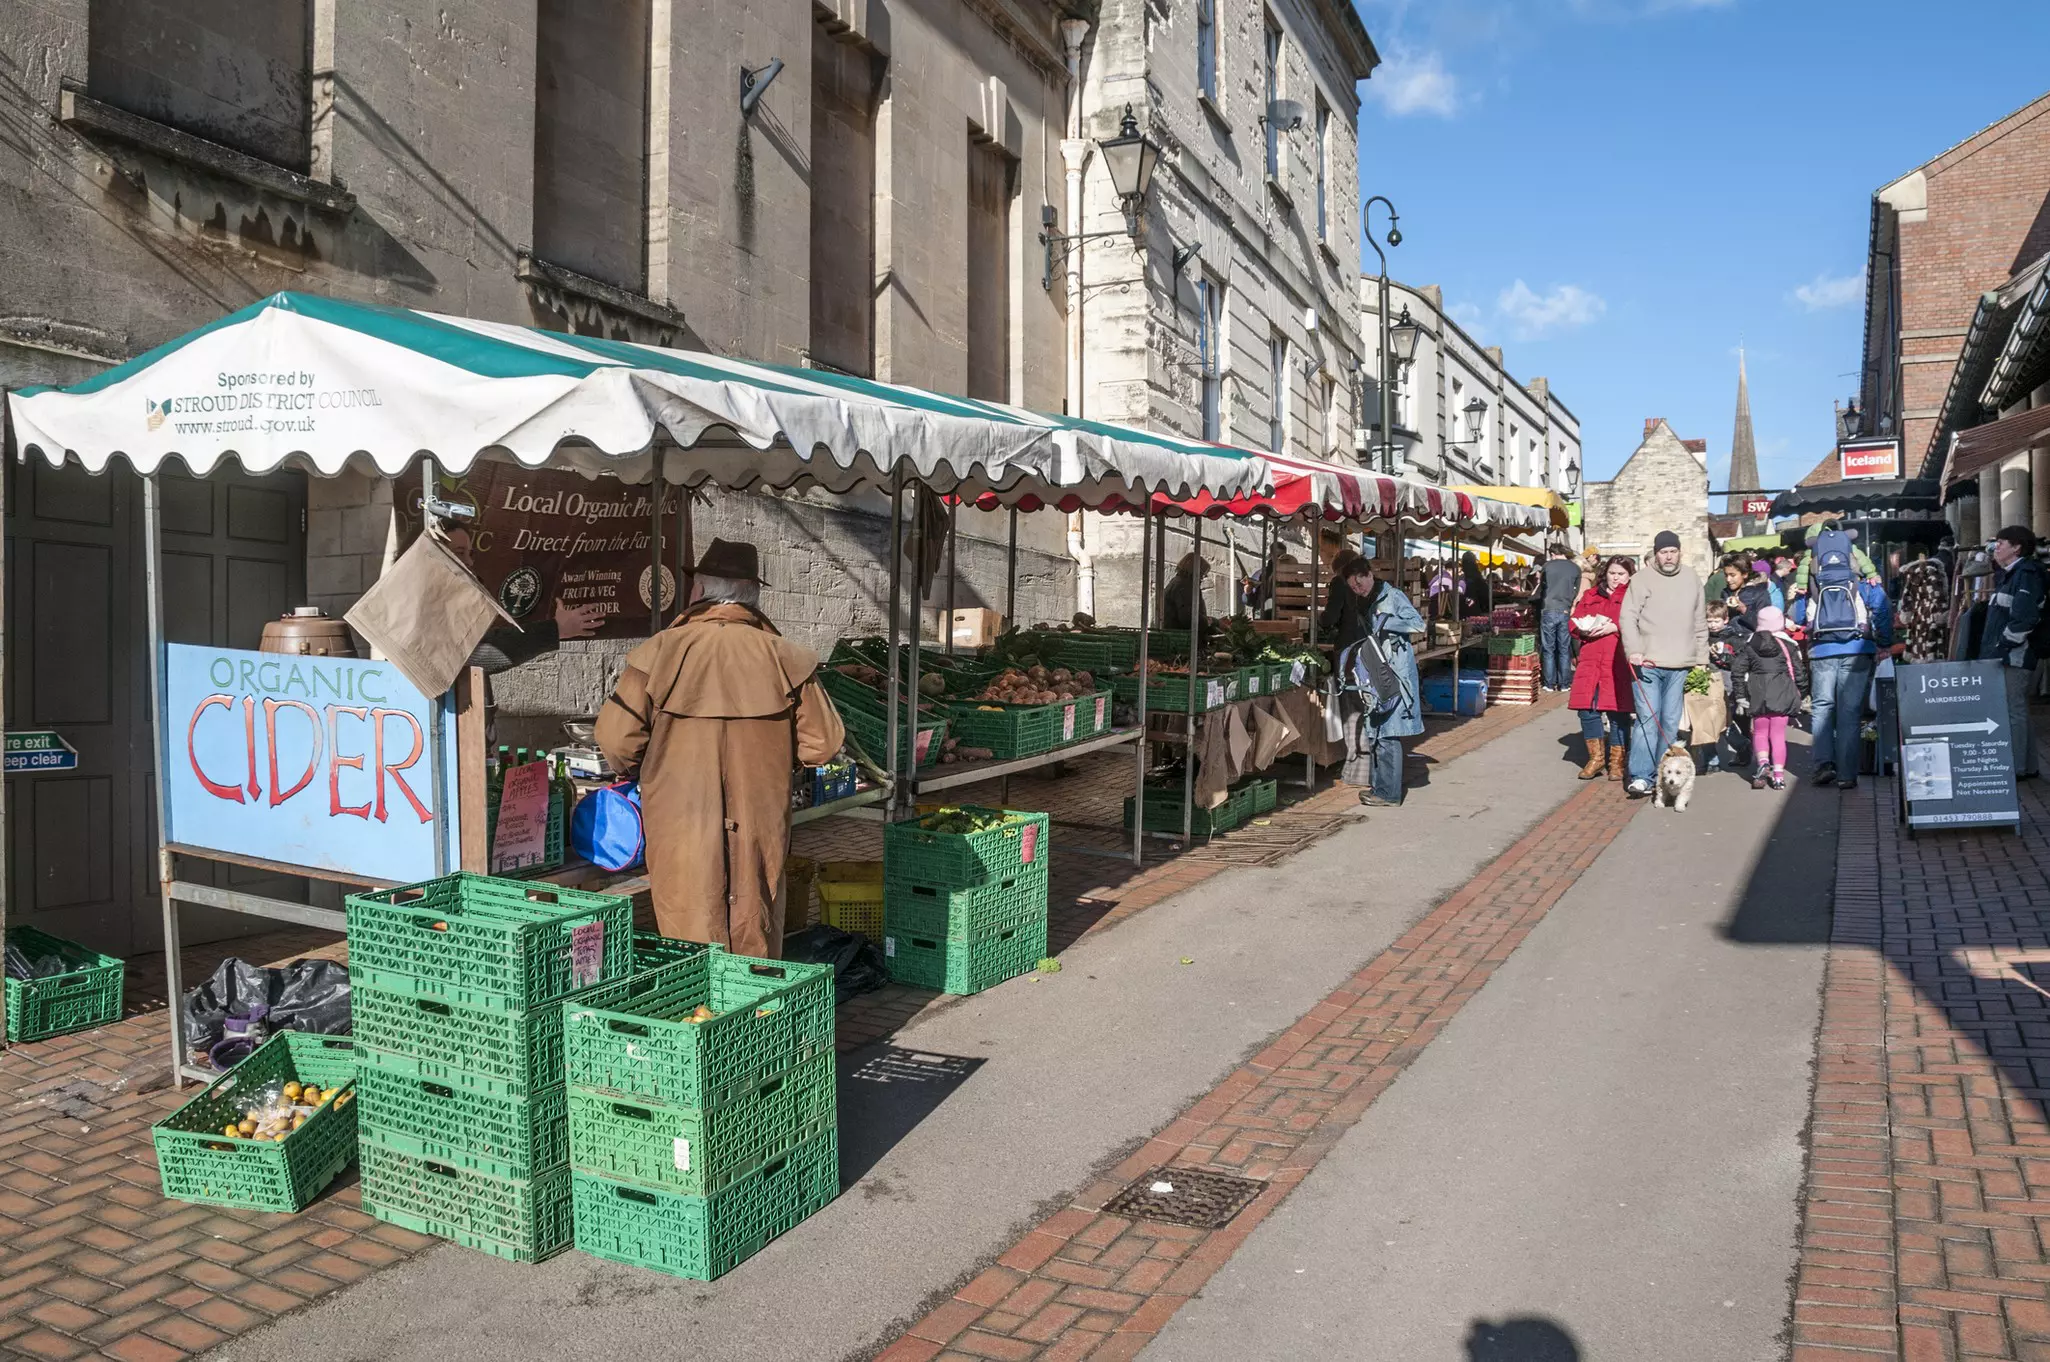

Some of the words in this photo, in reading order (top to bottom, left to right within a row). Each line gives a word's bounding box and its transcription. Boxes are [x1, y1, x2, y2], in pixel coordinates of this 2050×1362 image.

[218, 371, 296, 390] Sponsored
[300, 370, 314, 388] by
[174, 394, 238, 413] STROUD
[240, 392, 315, 410] DISTRICT
[318, 389, 382, 410] COUNCIL
[174, 415, 315, 434] www.stroud.gov.uk
[1847, 453, 1892, 467] Iceland
[502, 486, 564, 515] Local
[566, 491, 632, 524] Organic
[512, 529, 570, 552] Direct
[566, 532, 607, 558] from
[608, 532, 629, 551] the
[561, 570, 587, 582] Award
[588, 569, 622, 583] Winning
[562, 586, 590, 599] FRUIT
[590, 586, 596, 598] &
[598, 586, 616, 597] VEG
[210, 657, 388, 703] ORGANIC
[1920, 674, 1982, 694] JOSEPH
[1924, 694, 1980, 704] HAIRDRESSING
[24, 735, 50, 749] exit
[4, 756, 28, 768] eep
[31, 752, 63, 765] clear
[188, 693, 434, 824] CIDER
[1958, 780, 2008, 788] Appointments
[1972, 788, 2010, 796] Necessary
[574, 924, 600, 936] LOCAL
